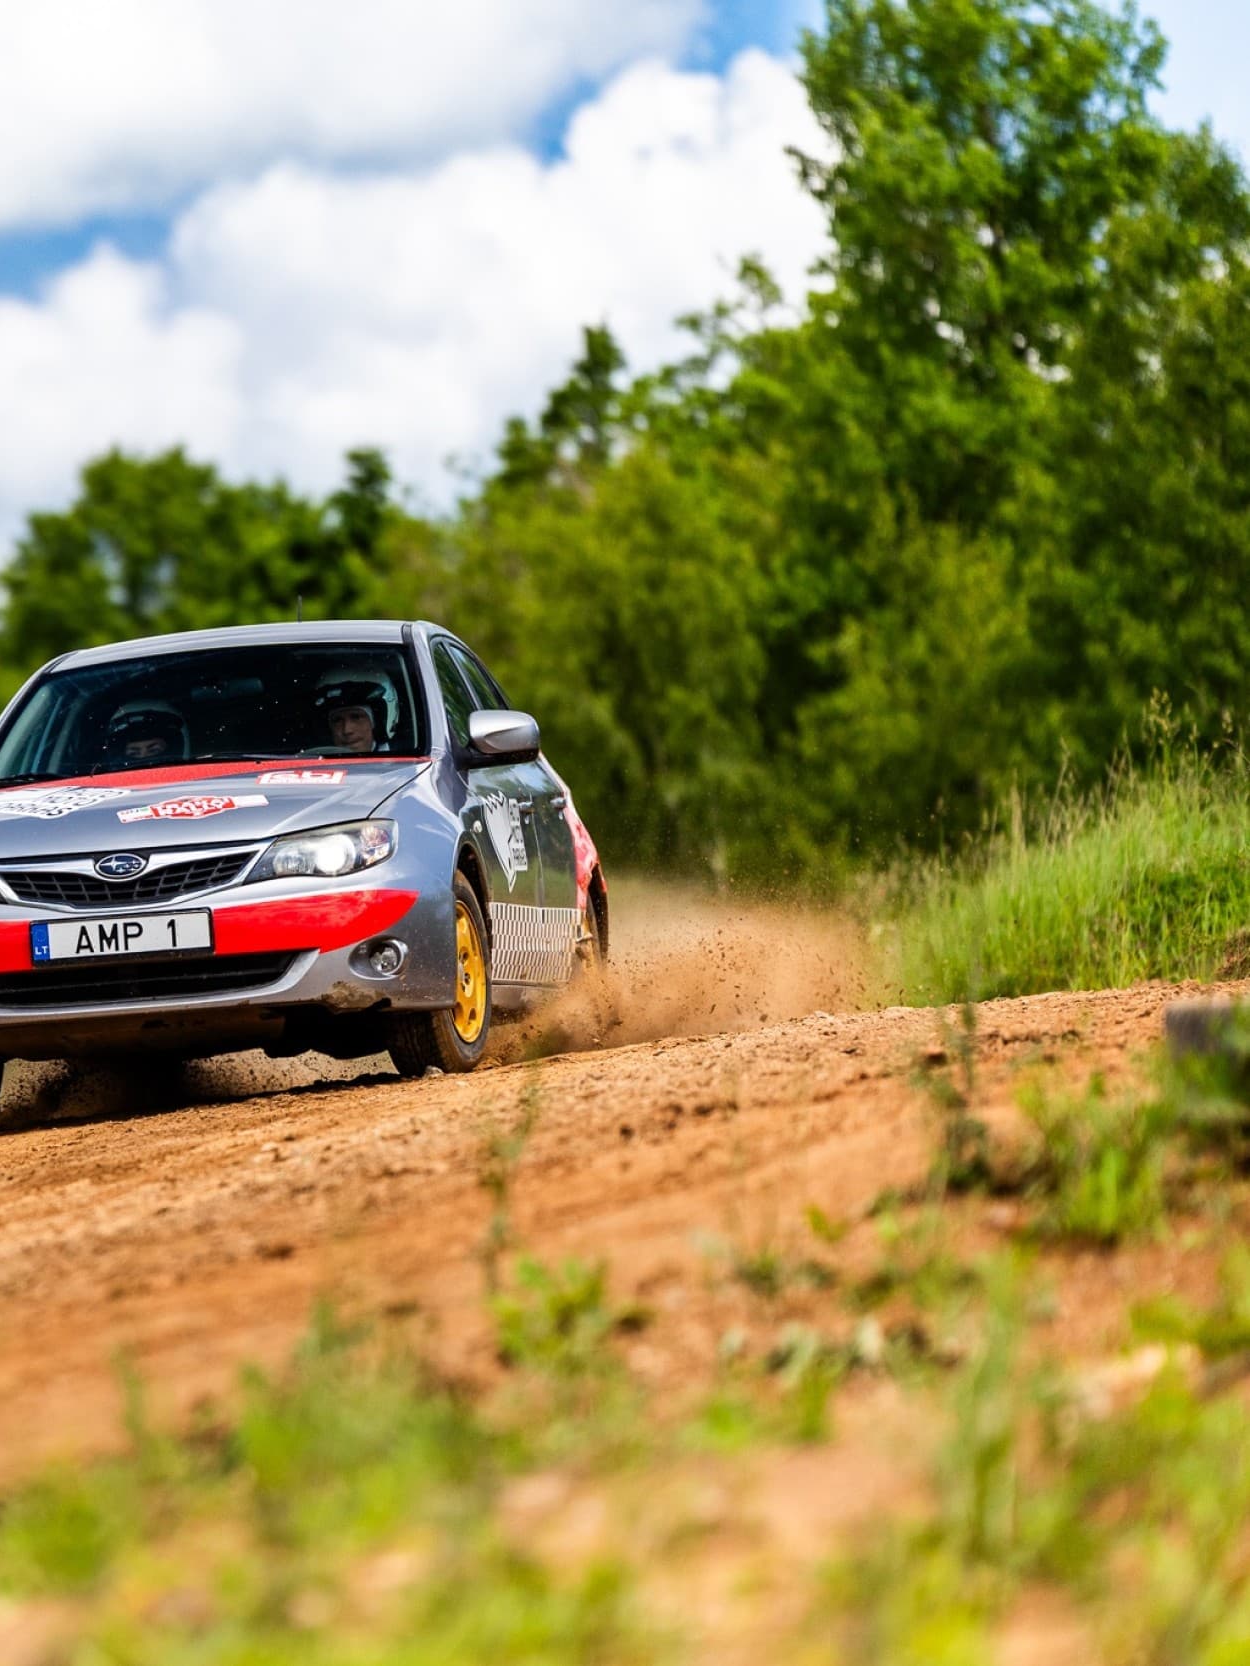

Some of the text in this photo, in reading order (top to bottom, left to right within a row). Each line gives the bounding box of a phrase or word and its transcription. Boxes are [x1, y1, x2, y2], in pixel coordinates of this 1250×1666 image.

[75, 919, 177, 954] AMP 1
[35, 945, 48, 955] LT
